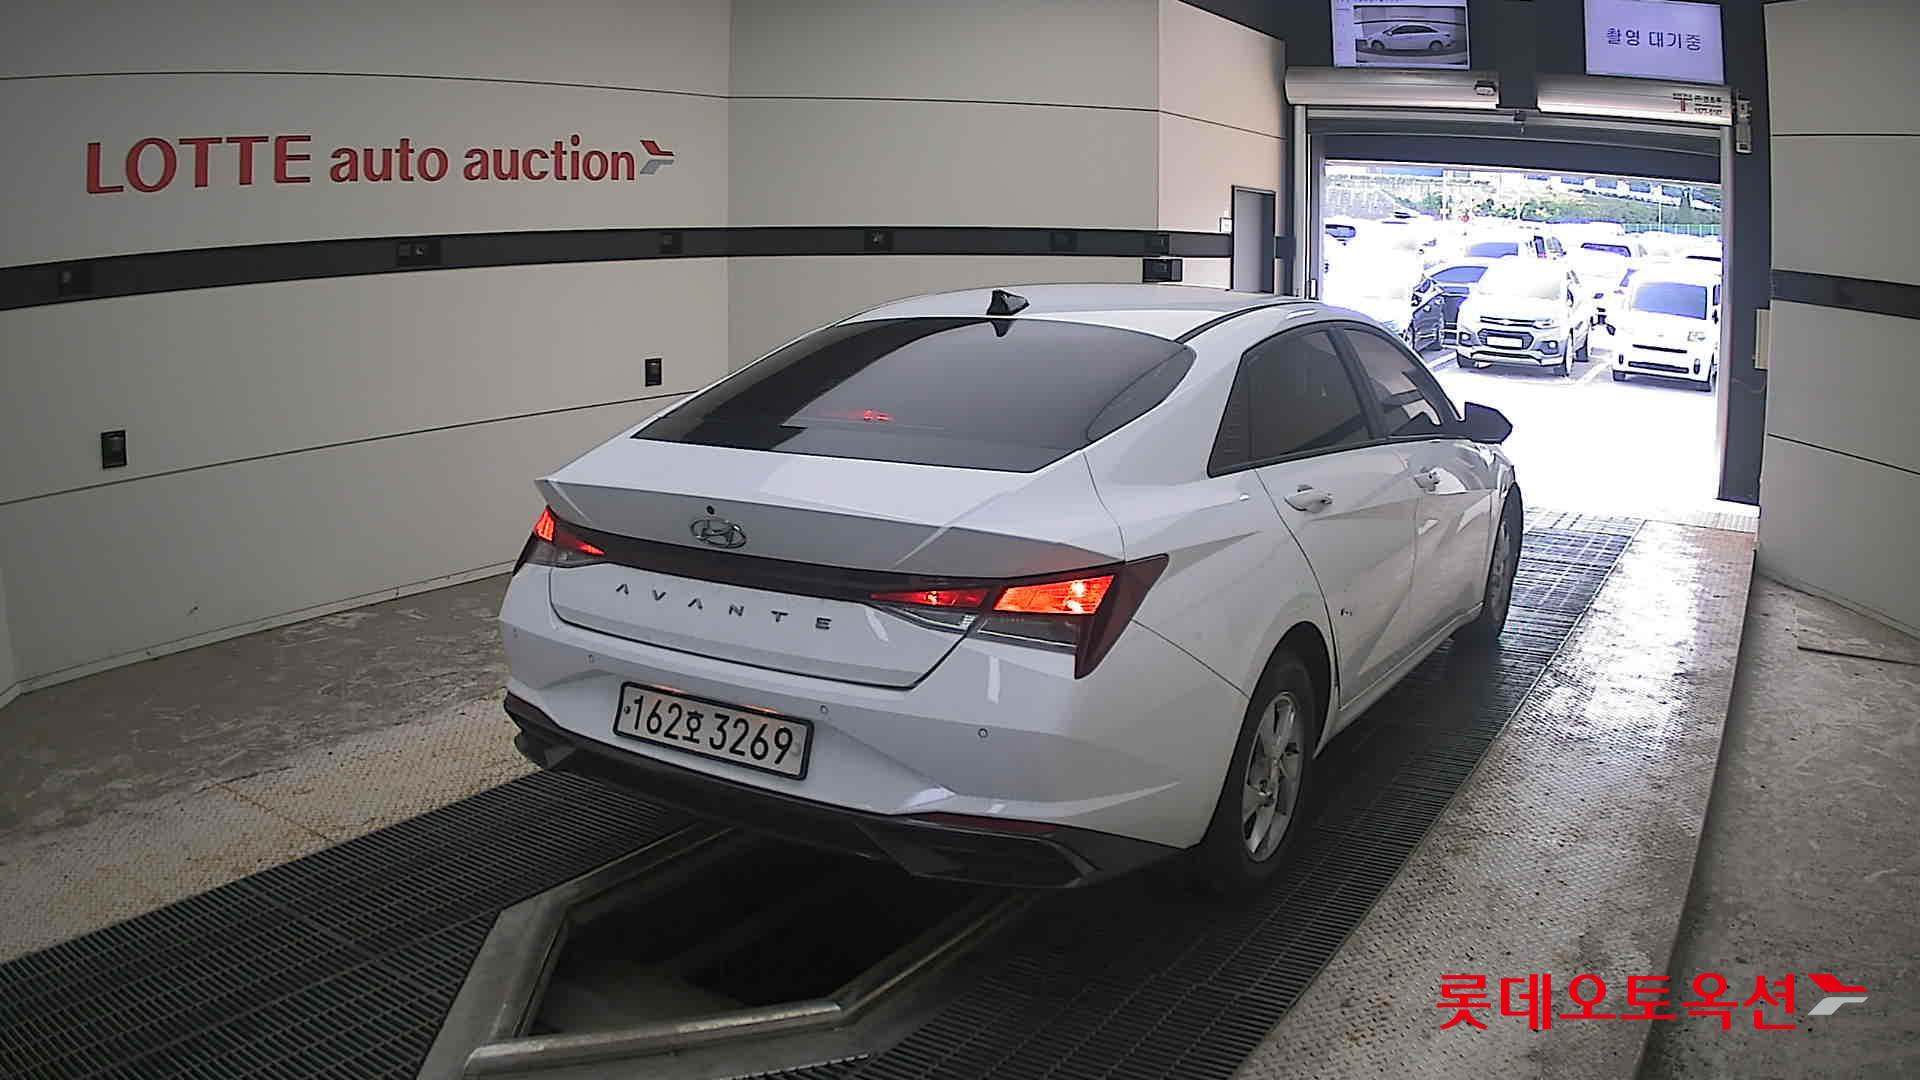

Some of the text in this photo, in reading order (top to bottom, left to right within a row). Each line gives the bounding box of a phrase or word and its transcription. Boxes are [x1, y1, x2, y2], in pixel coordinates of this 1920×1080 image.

[1607, 28, 1701, 51] 촬영 대기중
[86, 134, 635, 193] LOTTE auto auction
[616, 583, 832, 630] AVANTE
